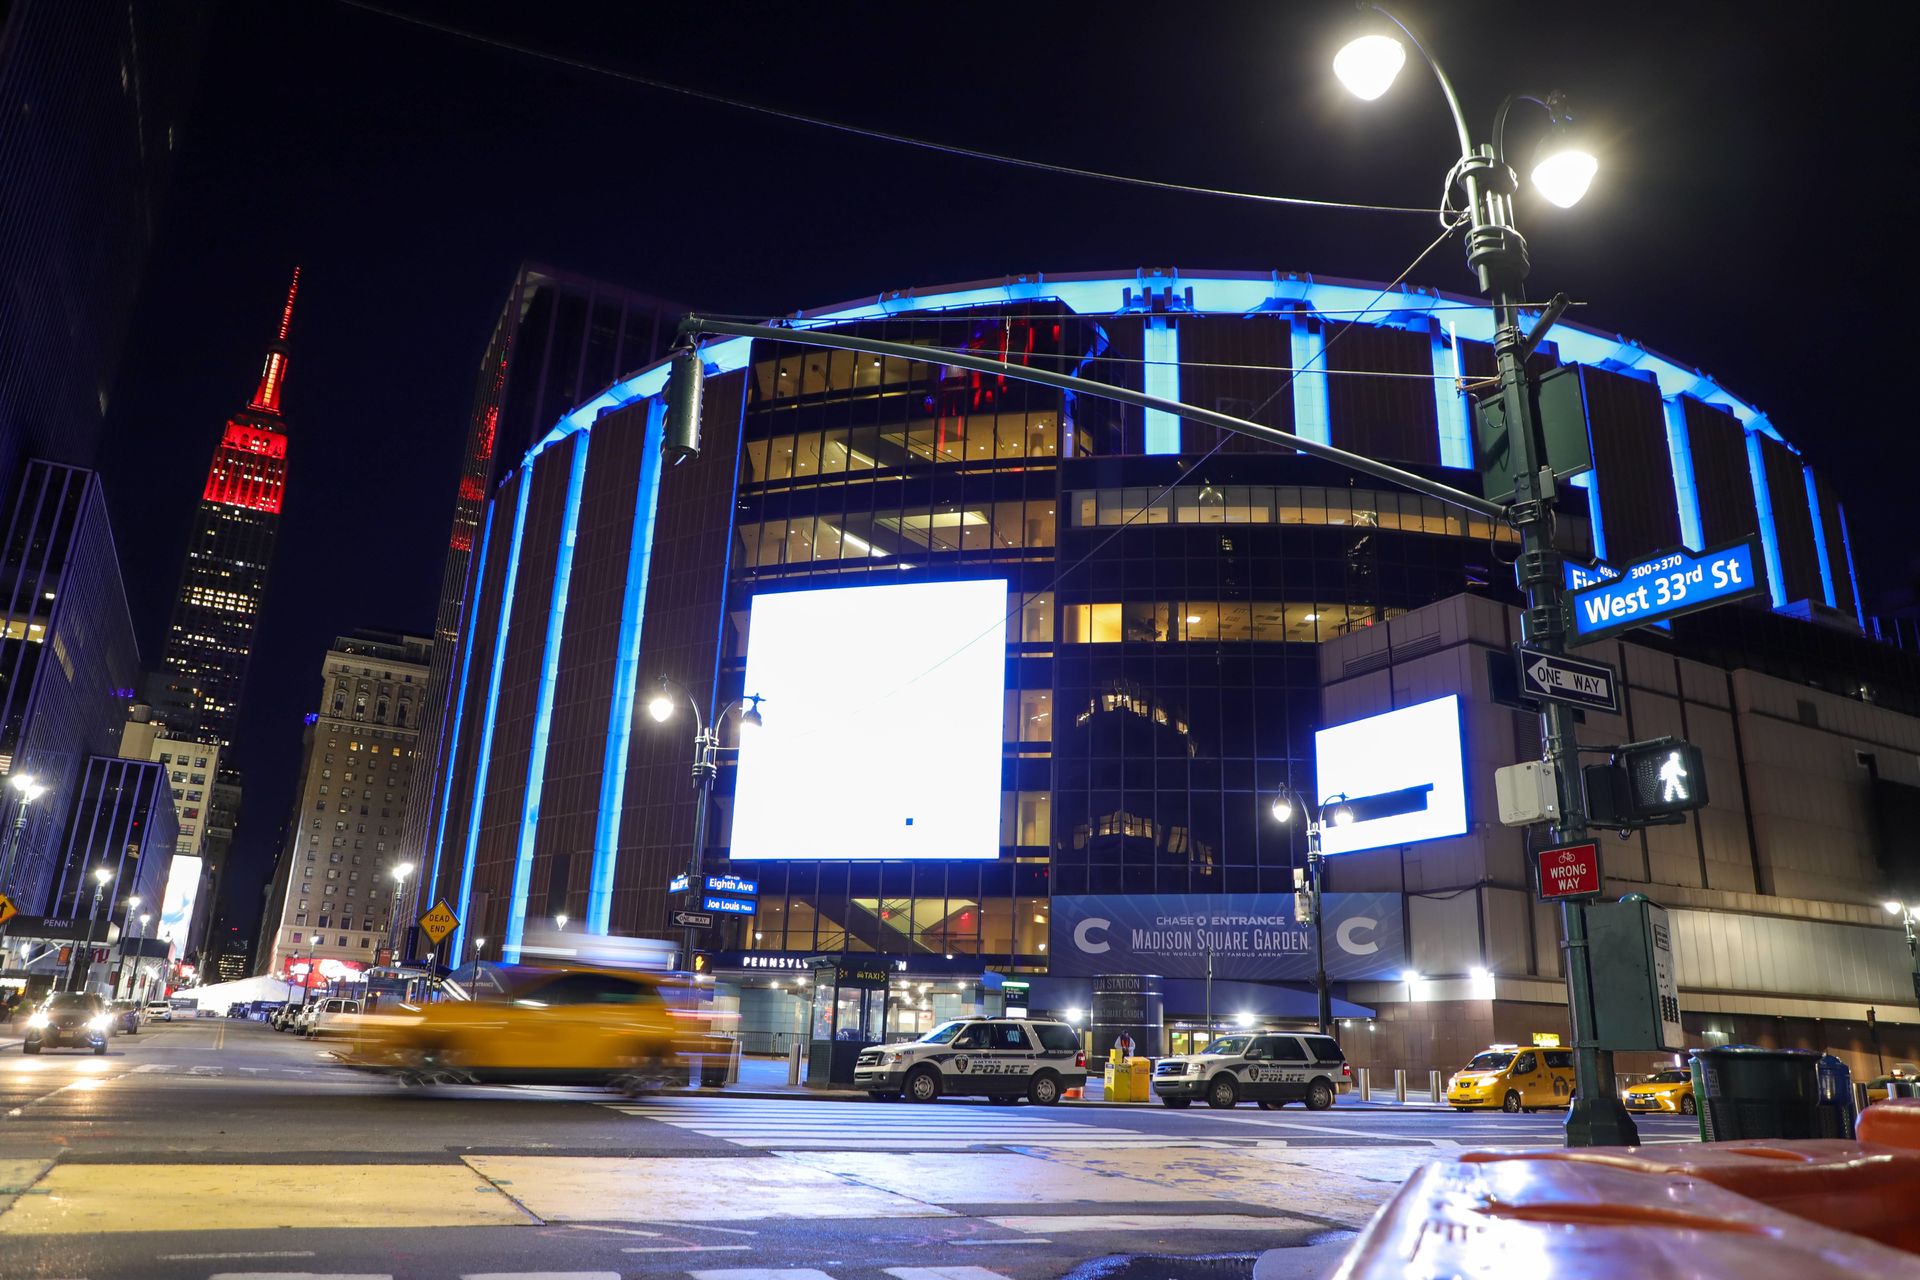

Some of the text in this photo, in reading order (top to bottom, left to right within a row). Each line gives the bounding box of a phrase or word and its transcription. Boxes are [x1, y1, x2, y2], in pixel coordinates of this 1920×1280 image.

[1631, 554, 1682, 580] 300 370
[1584, 557, 1742, 624] West 33rd St
[1537, 666, 1599, 694] ONE WAY
[1550, 863, 1587, 879] WRONG
[709, 878, 754, 892] Eighth Ave
[1558, 877, 1580, 891] WAY
[707, 899, 720, 909] Joe
[721, 900, 740, 911] Louis
[43, 919, 69, 928] PENN
[429, 914, 450, 923] DEAD
[1156, 916, 1285, 926] CHASE ENTRANCE
[430, 925, 446, 933] END
[1132, 928, 1192, 950] MADISON
[864, 970, 880, 981] TAXI
[1106, 978, 1140, 990] STATION
[971, 1064, 1030, 1074] POLICE
[1259, 1073, 1305, 1083] POLICE
